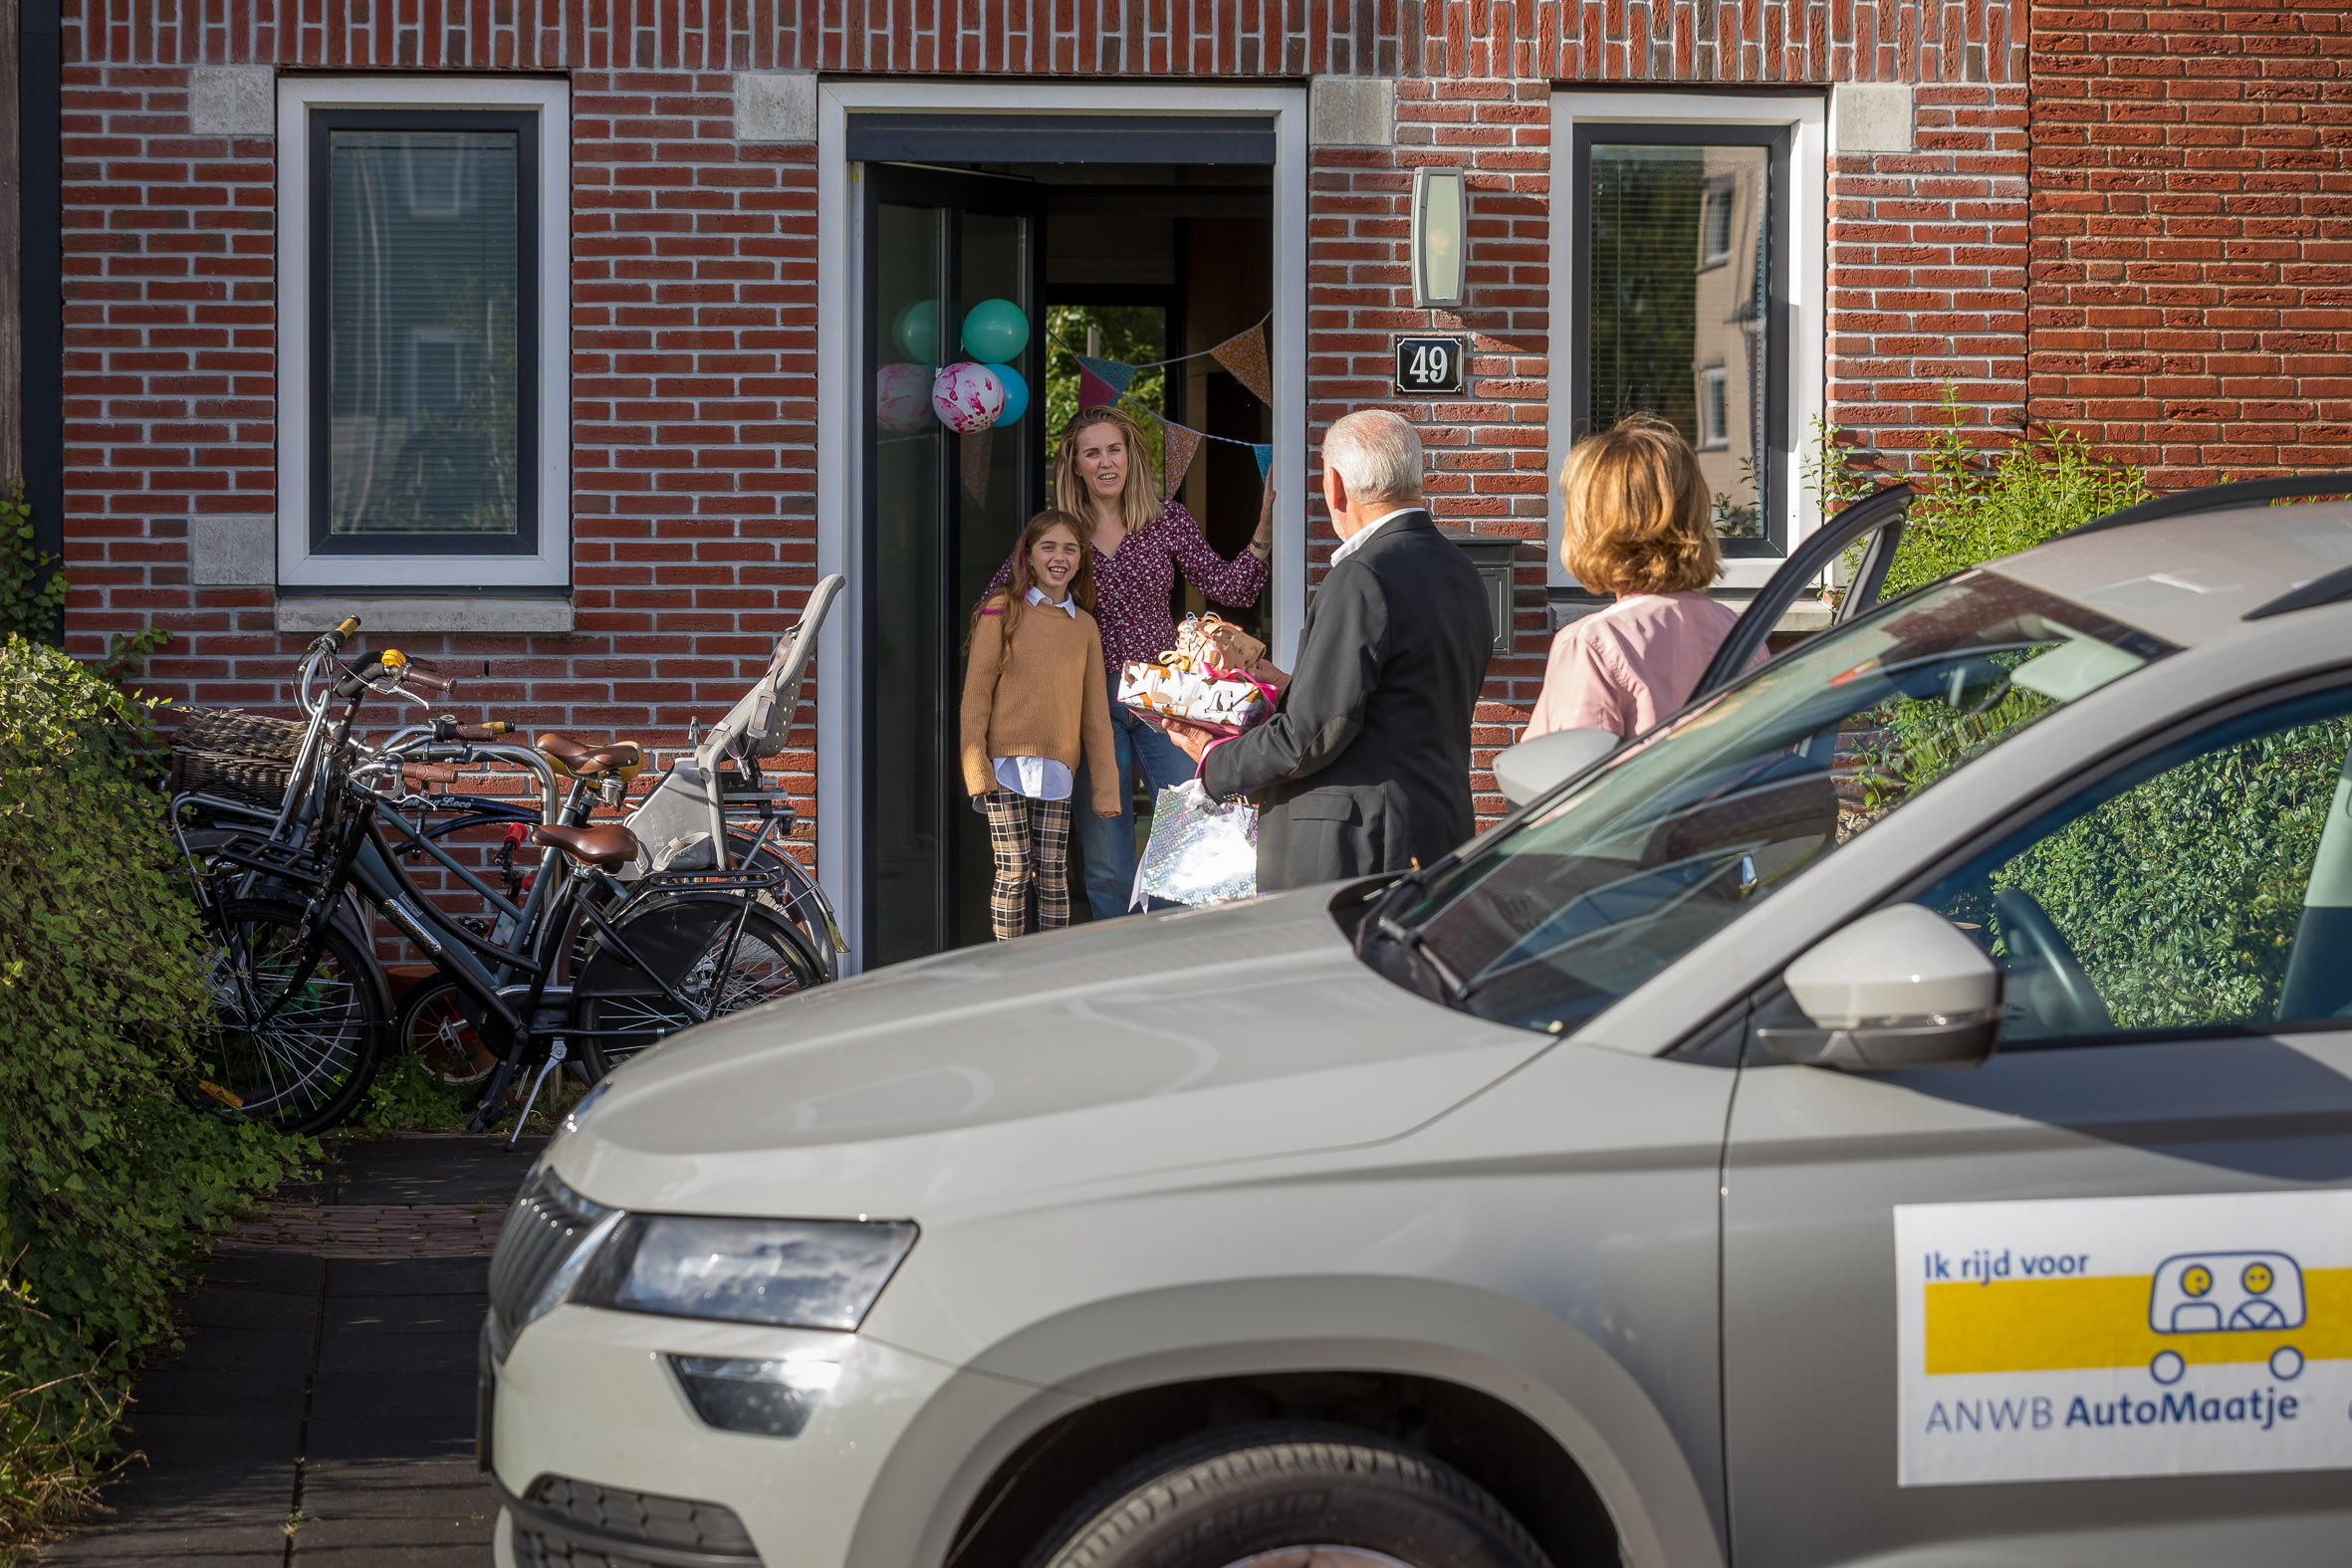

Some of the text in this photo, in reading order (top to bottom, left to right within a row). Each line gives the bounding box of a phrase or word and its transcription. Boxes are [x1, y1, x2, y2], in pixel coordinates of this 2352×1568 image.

[1409, 345, 1448, 383] 49
[440, 796, 472, 808] Loco
[1924, 1248, 2089, 1286] Ik rijd voor
[1924, 1397, 2053, 1434] ANWB
[2063, 1387, 2299, 1432] AutoMaatje
